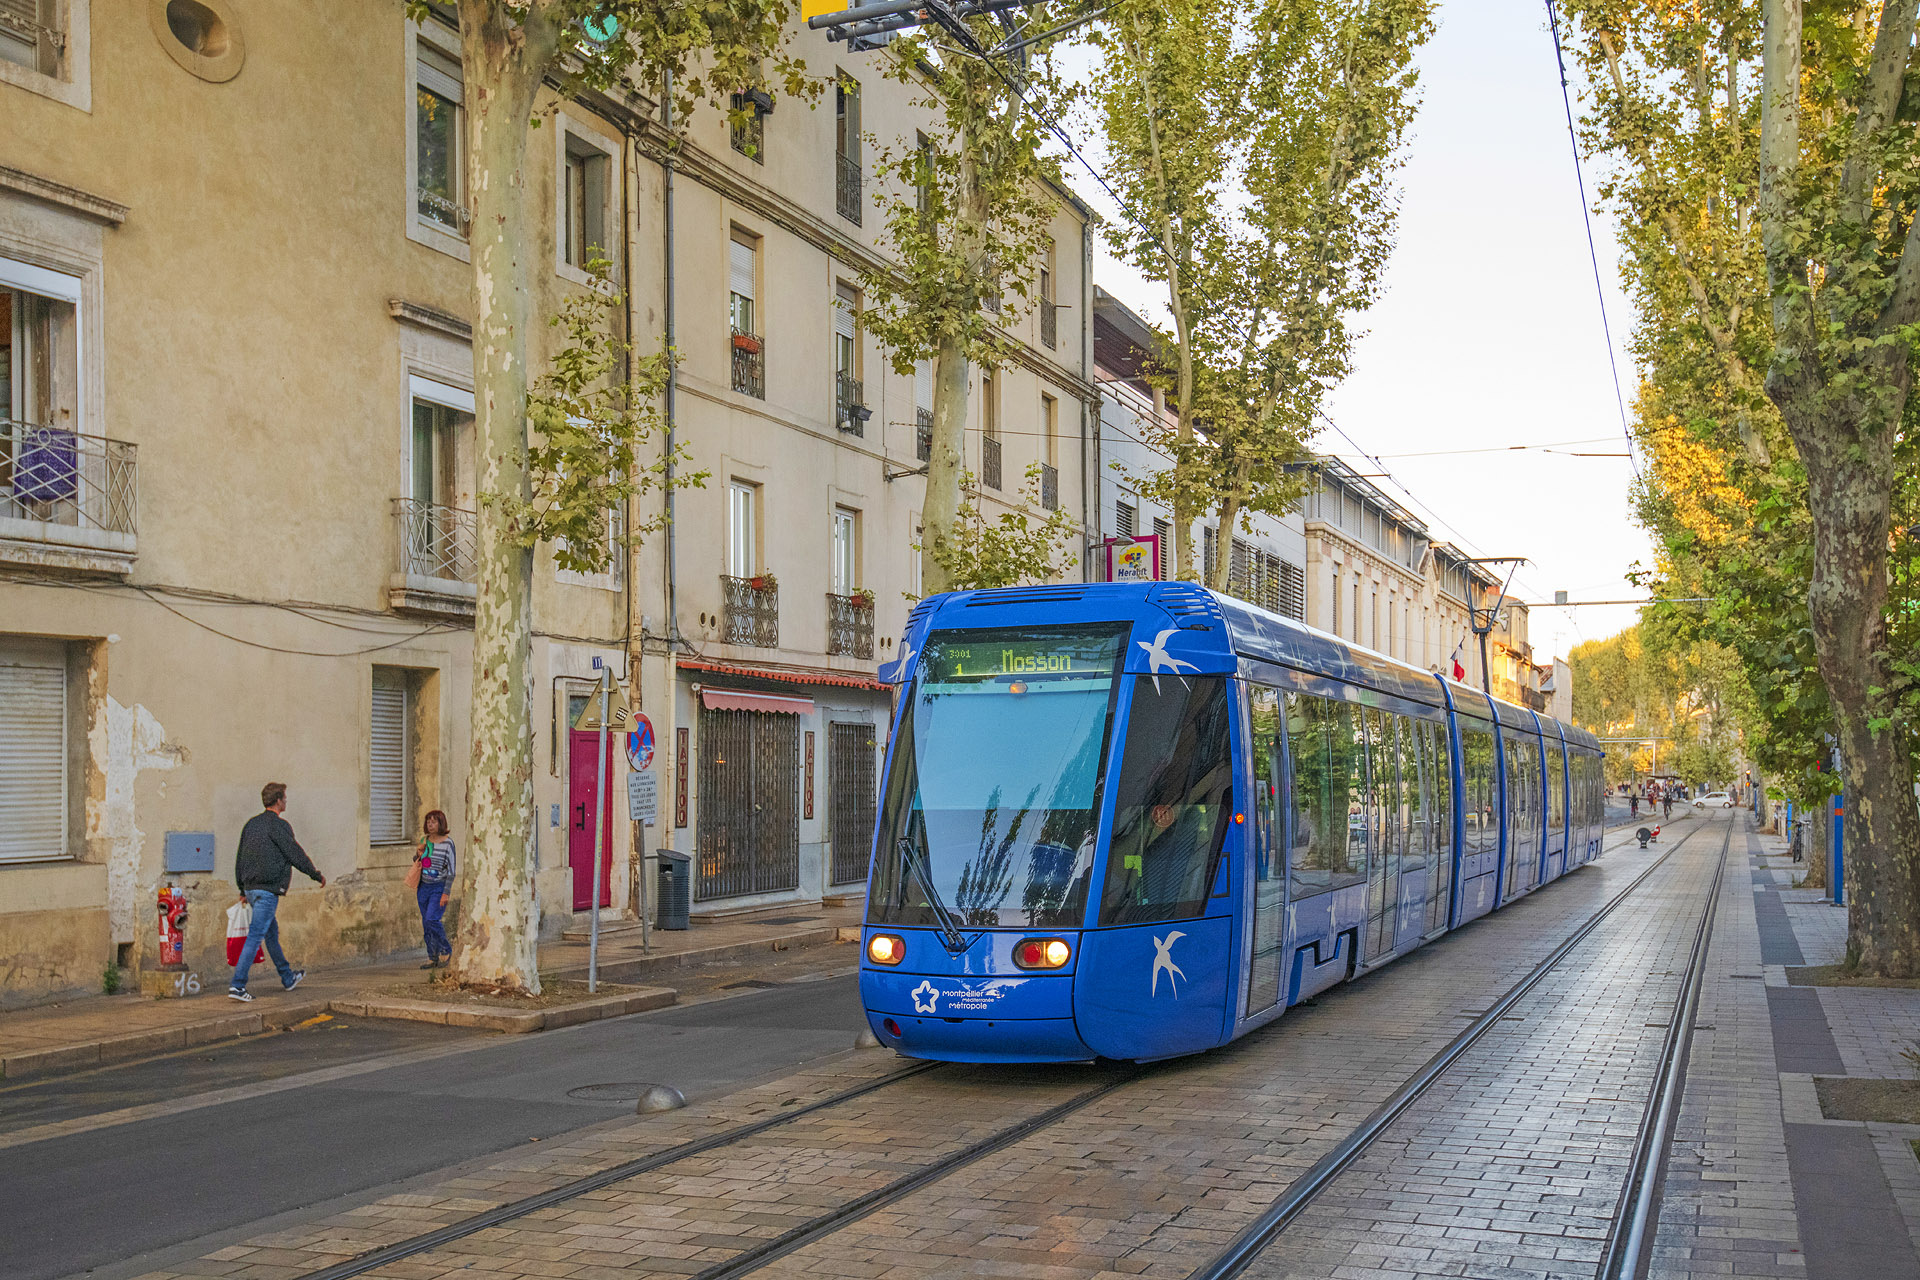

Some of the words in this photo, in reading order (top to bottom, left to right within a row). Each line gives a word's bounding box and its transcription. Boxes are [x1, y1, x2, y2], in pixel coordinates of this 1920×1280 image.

[955, 663, 963, 676] 1
[1002, 649, 1071, 673] Mosson
[678, 731, 687, 823] TATTOO
